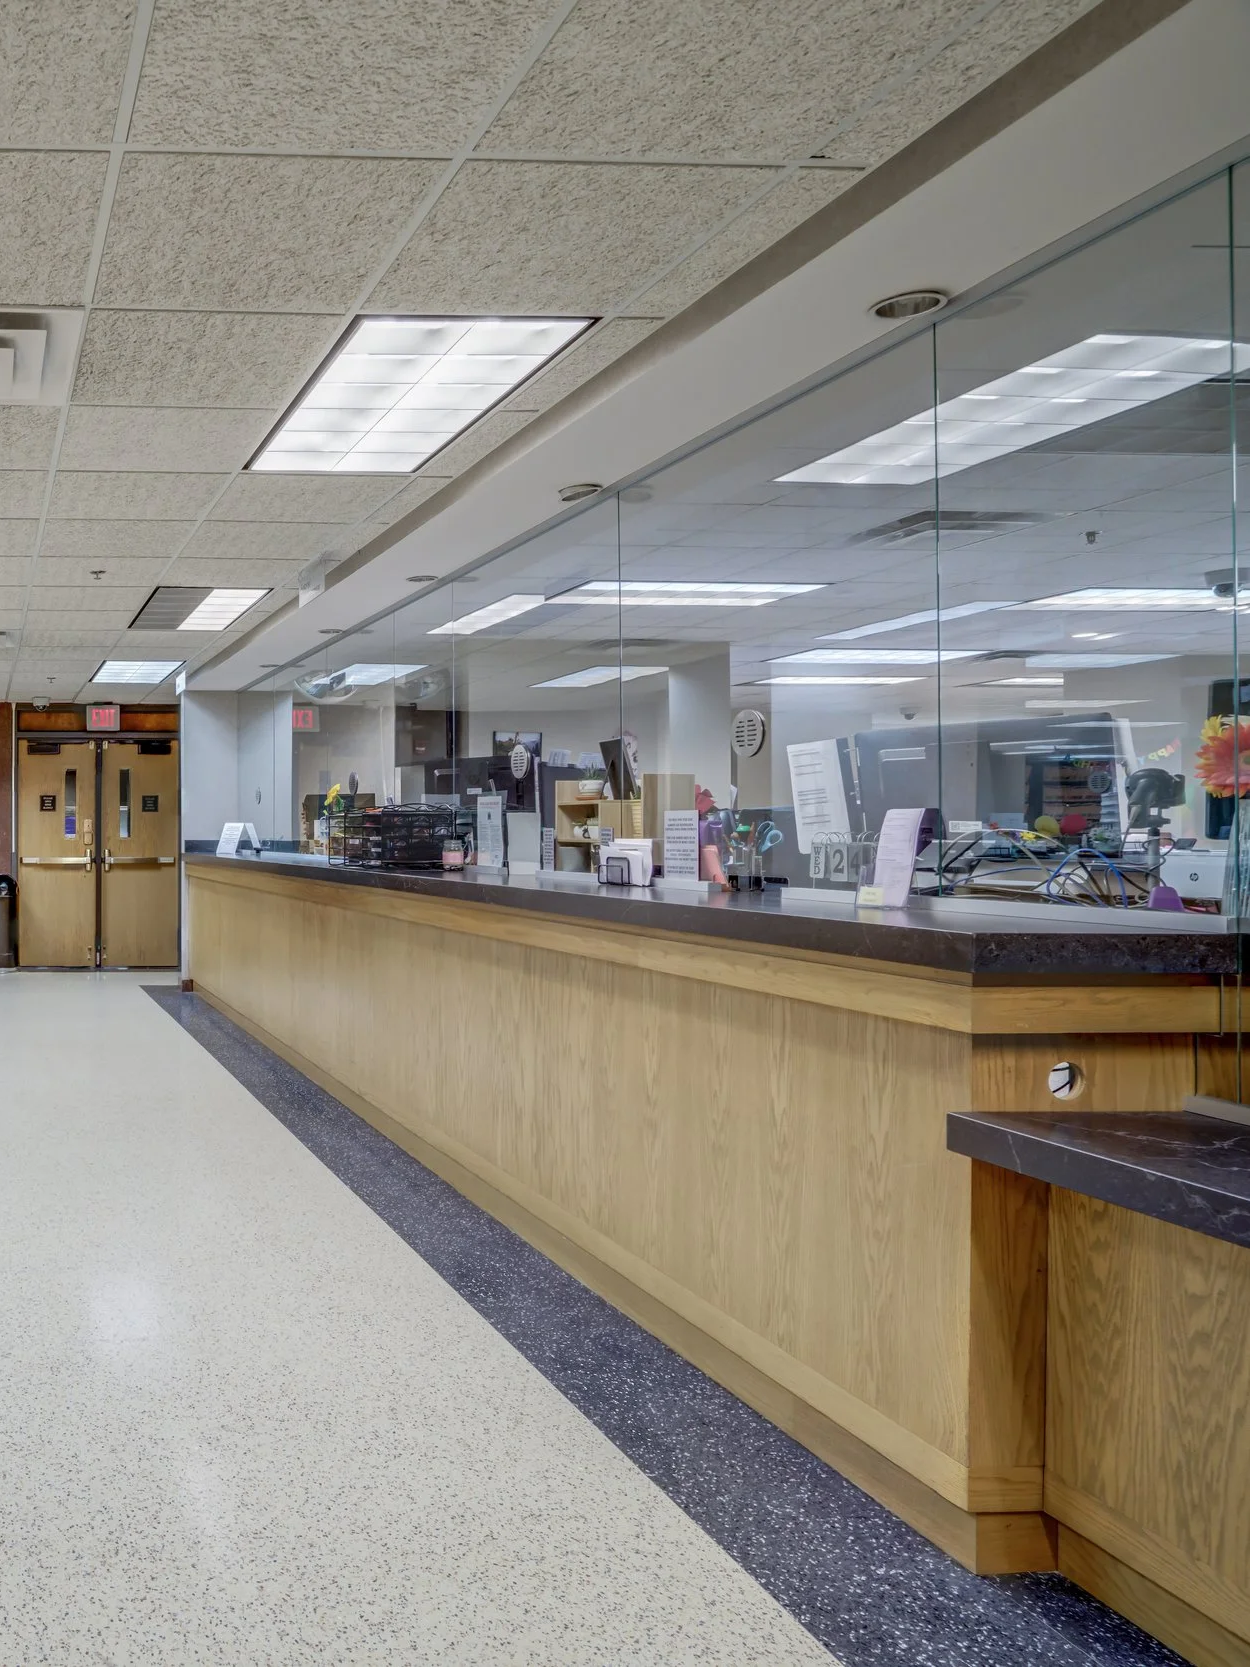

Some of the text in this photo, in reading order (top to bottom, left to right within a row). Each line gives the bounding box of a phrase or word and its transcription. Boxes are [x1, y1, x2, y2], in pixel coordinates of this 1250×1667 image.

[92, 708, 116, 727] EXIT
[813, 846, 822, 875] WED
[832, 848, 859, 876] 24
